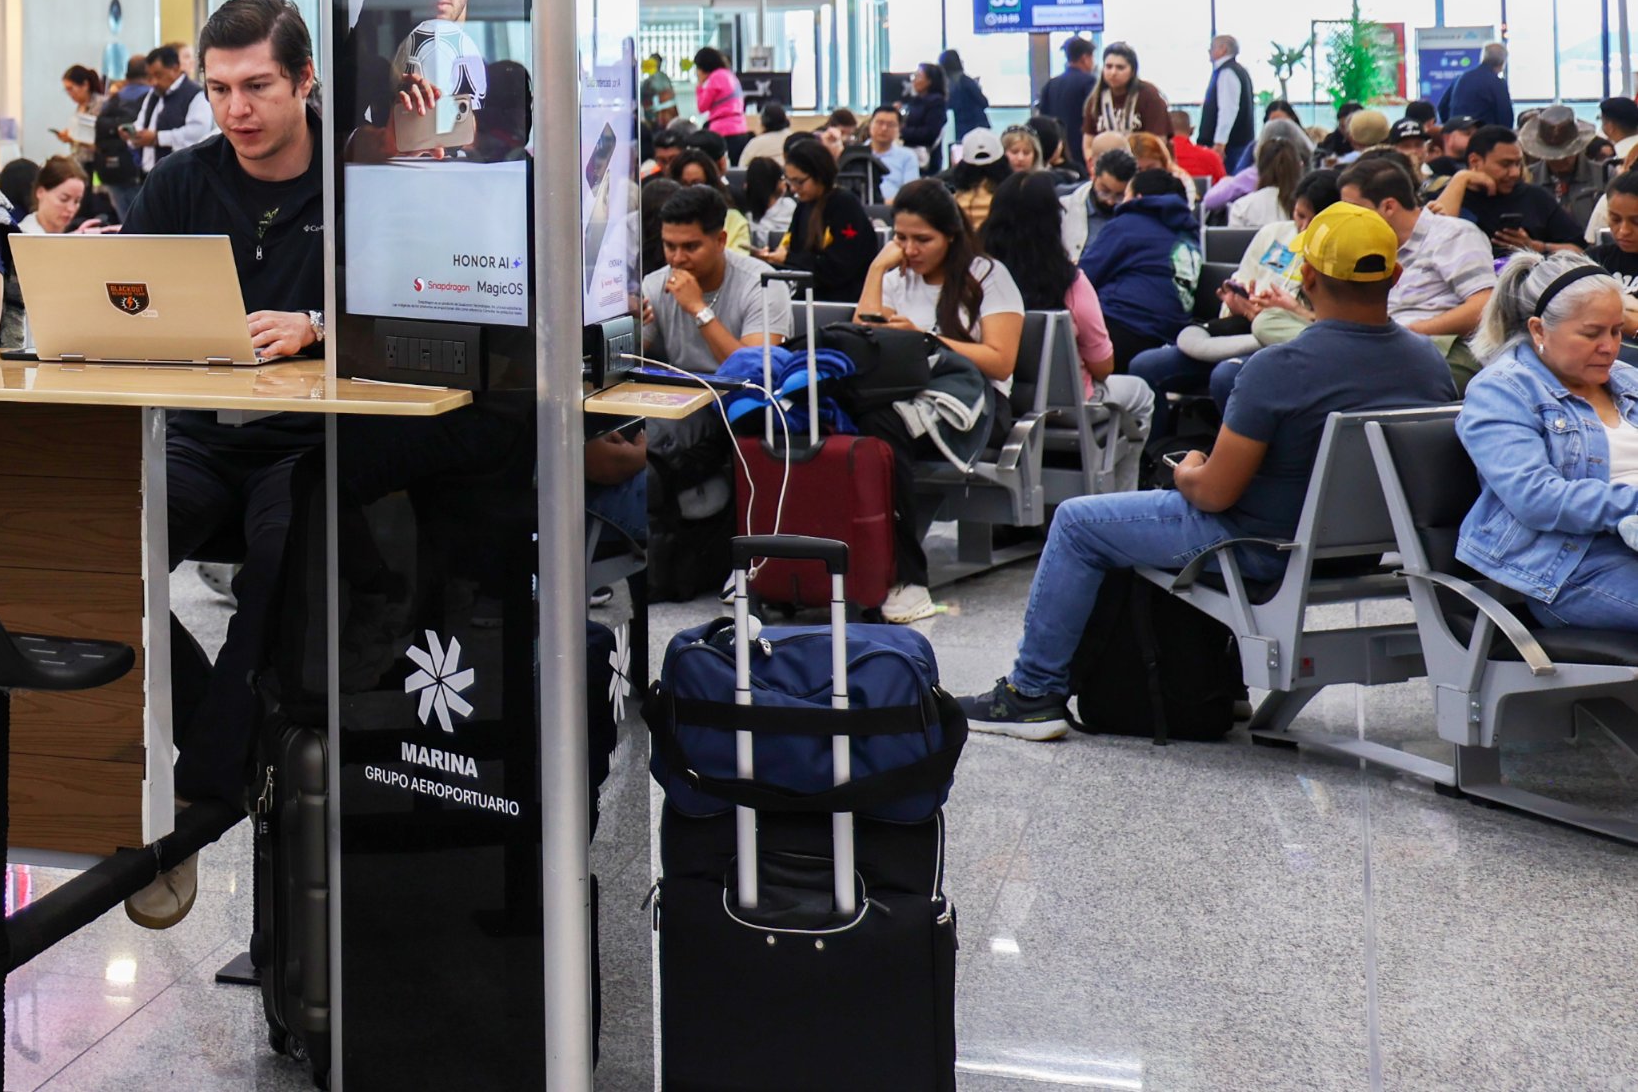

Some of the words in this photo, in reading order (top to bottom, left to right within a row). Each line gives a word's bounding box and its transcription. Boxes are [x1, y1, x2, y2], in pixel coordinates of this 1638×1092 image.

[453, 254, 495, 269] HONOR
[498, 256, 509, 269] AI
[427, 280, 470, 293] Snapdragon
[477, 280, 523, 297] MagicOS
[401, 741, 478, 778] MARINA
[365, 765, 408, 789] GRUPO
[411, 777, 519, 816] AEROPORTUARIO
